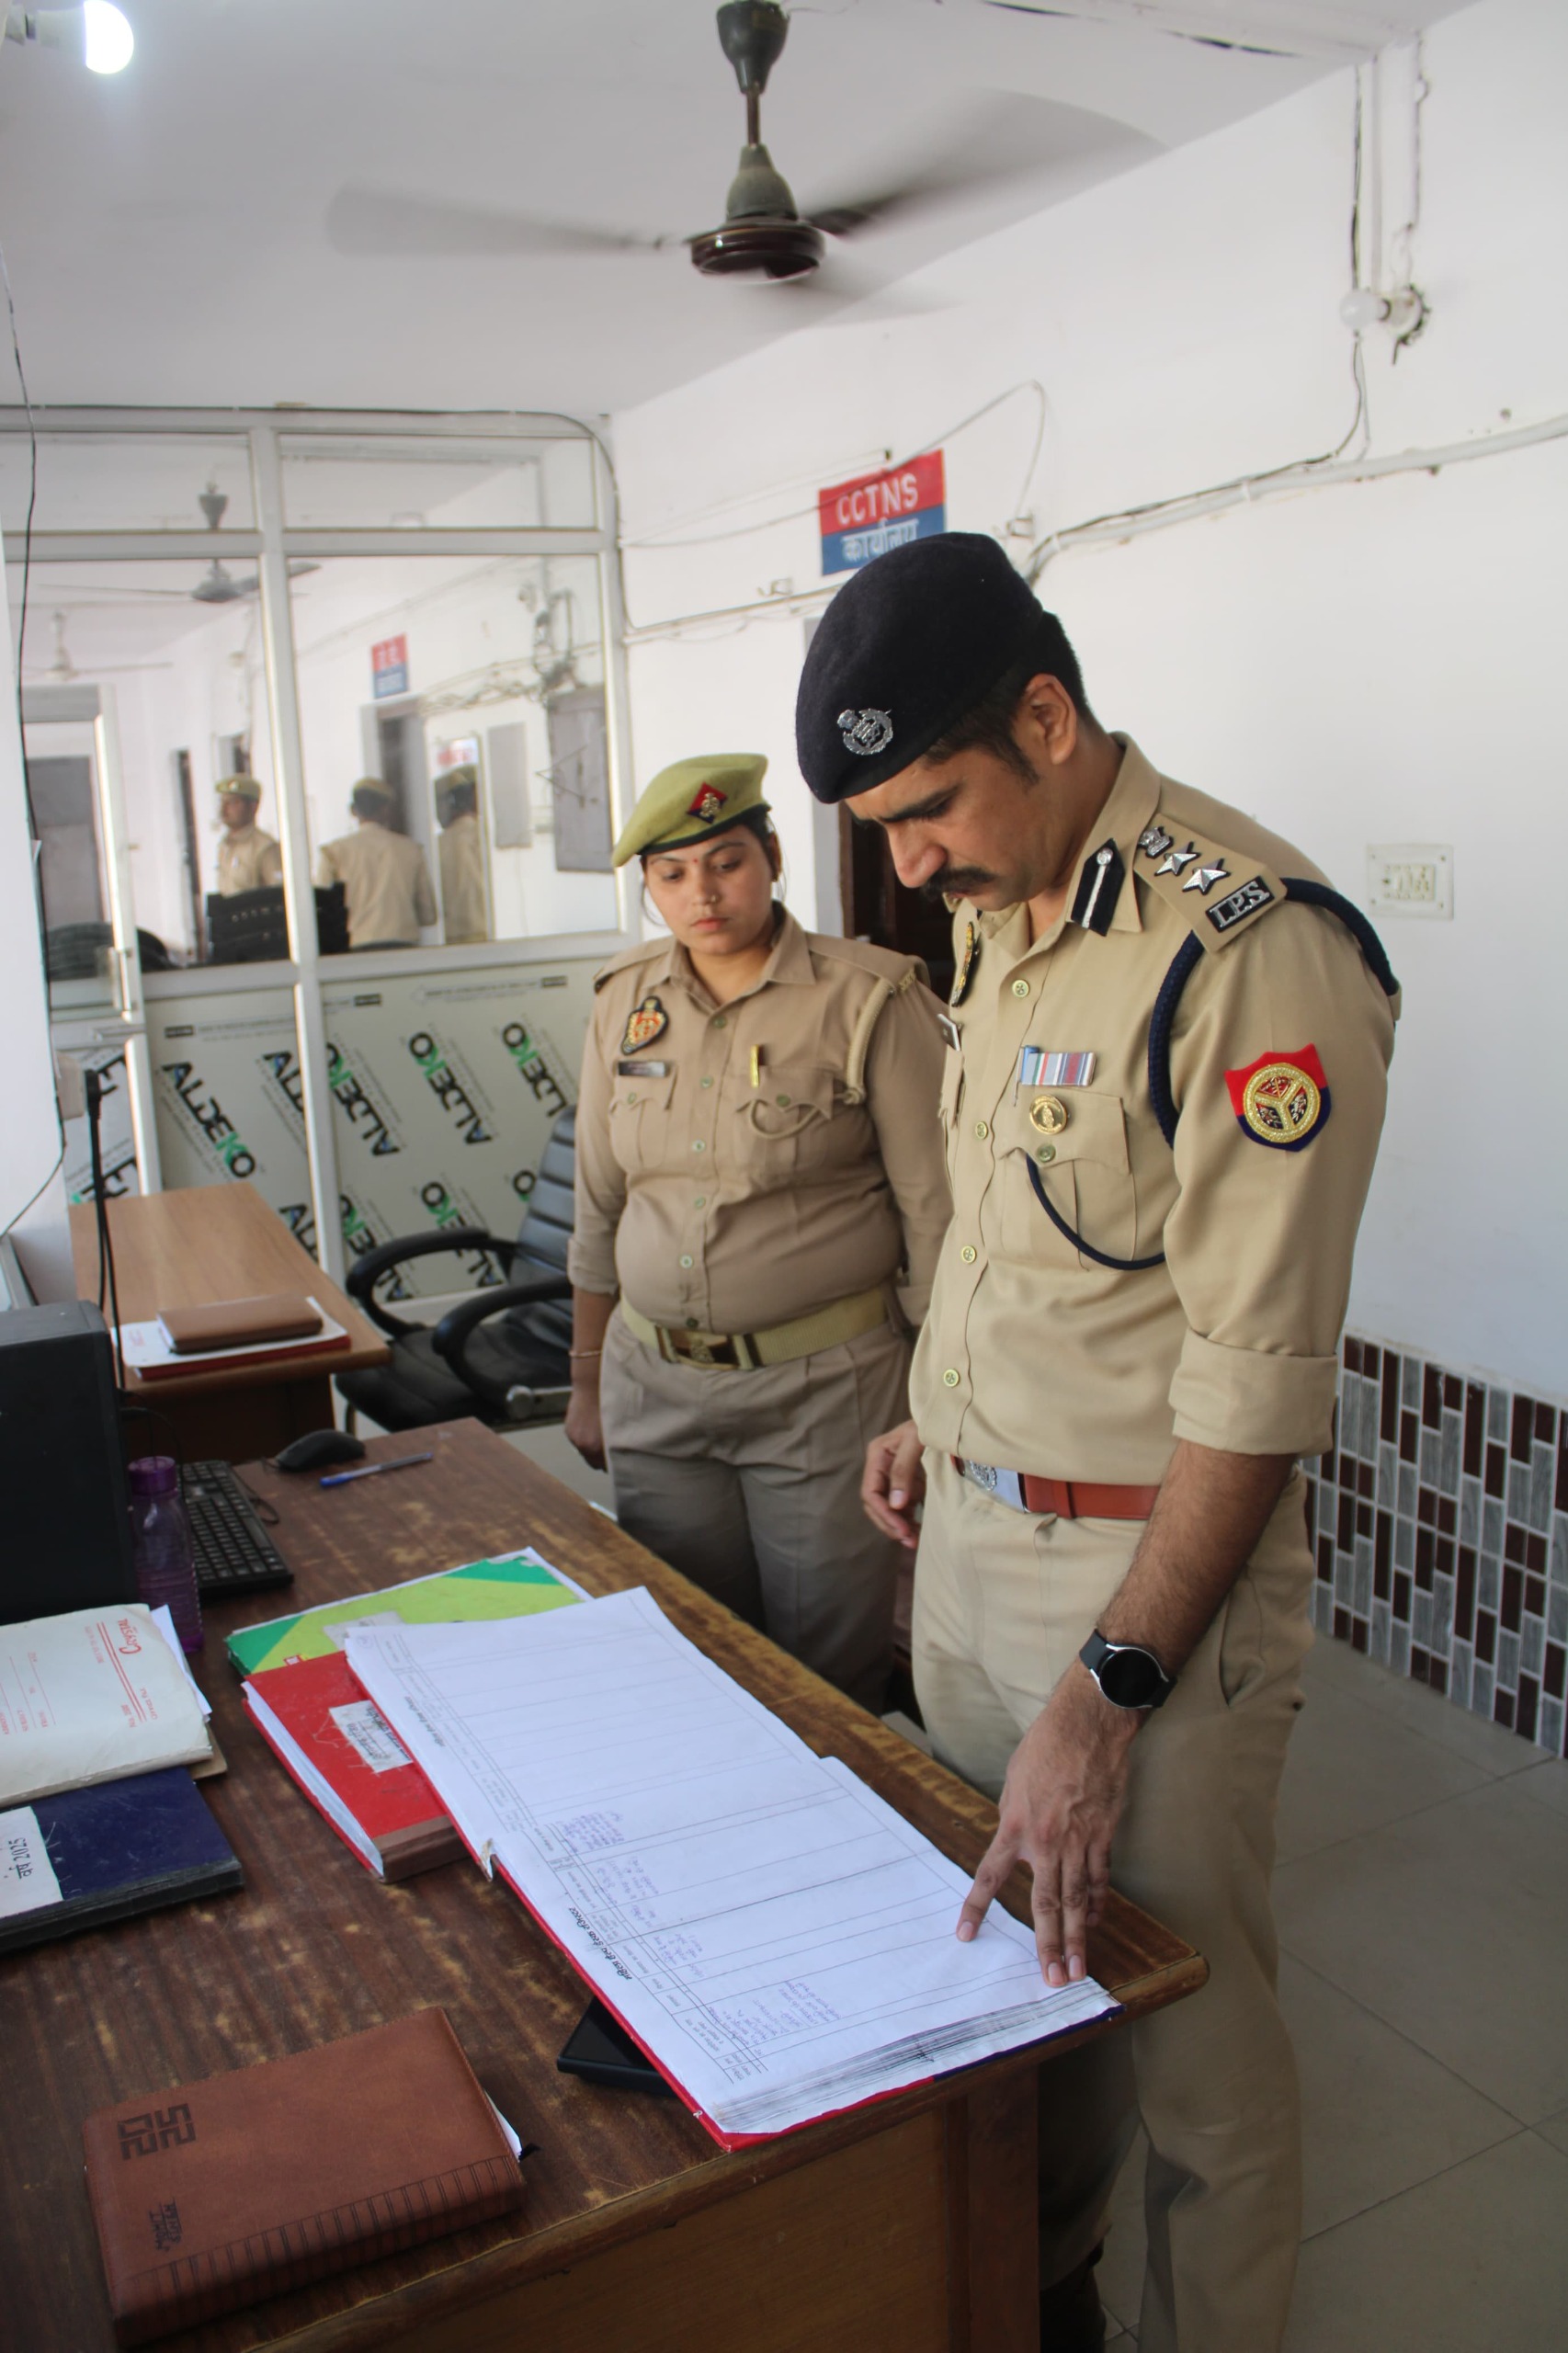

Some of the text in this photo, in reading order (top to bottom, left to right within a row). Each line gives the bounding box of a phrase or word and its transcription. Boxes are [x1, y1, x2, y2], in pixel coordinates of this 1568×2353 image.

[836, 472, 918, 525] CCTNS
[407, 1034, 492, 1143] ALDEKO
[501, 1025, 567, 1120] LDEKO
[161, 1063, 256, 1178] ALDEKO
[7, 1836, 30, 1860] 2025
[611, 1960, 632, 1981] महिला
